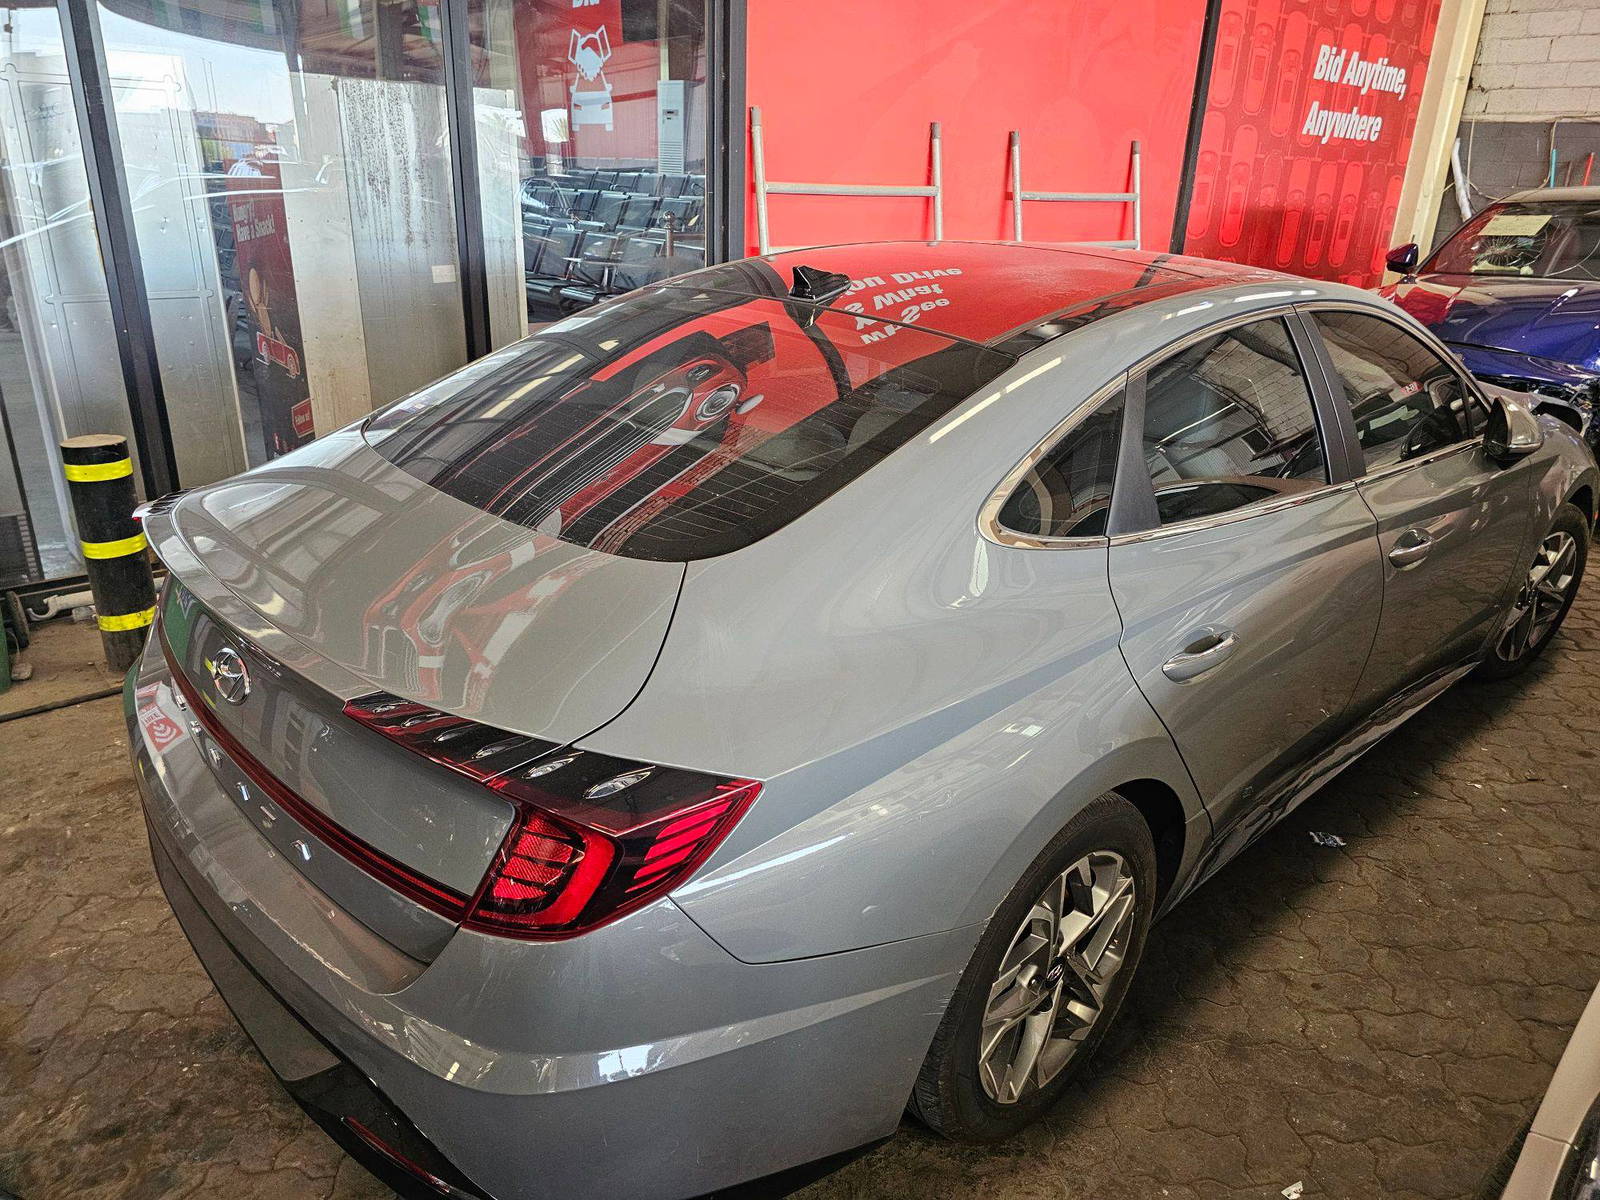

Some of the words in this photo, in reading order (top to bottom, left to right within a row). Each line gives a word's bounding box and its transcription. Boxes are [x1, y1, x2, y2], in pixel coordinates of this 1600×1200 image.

[1313, 44, 1347, 83] Bid
[1342, 51, 1407, 101] Anytime,
[1301, 101, 1383, 145] Anywhere
